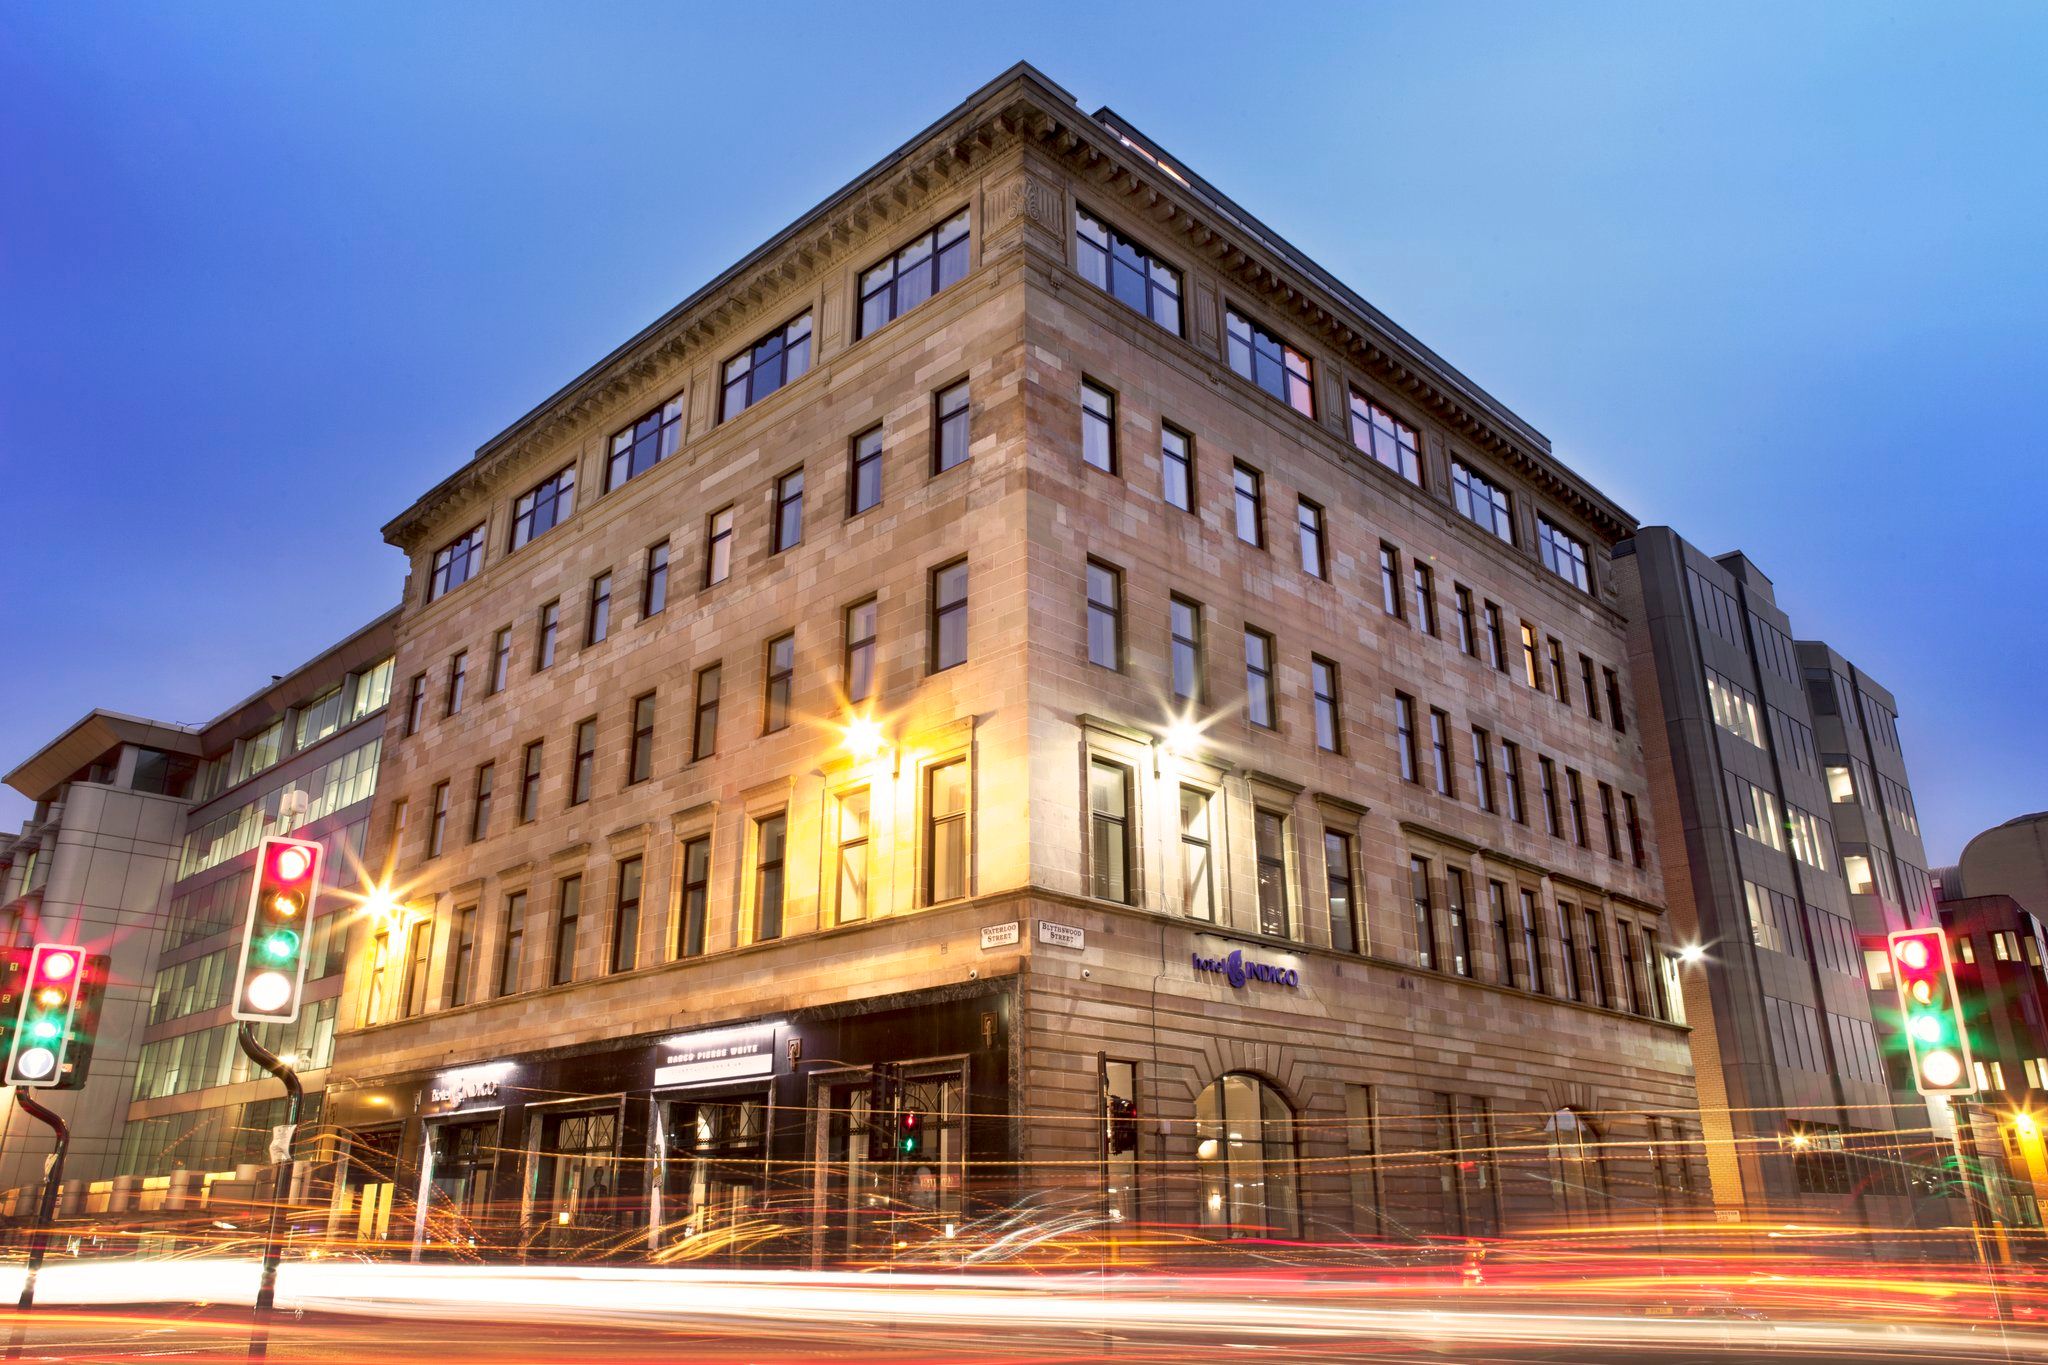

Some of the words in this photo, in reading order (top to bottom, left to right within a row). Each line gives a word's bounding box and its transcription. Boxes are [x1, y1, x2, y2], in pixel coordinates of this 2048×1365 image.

[983, 924, 1016, 935] WATERLOO
[1042, 922, 1082, 936] BLYTHSWOOD
[987, 933, 1012, 942] STREET
[1050, 932, 1074, 942] STREET
[1192, 952, 1228, 975] hotel
[1245, 961, 1299, 987] INDIGO
[697, 1048, 727, 1060] PIERRE
[730, 1044, 758, 1056] WHITE
